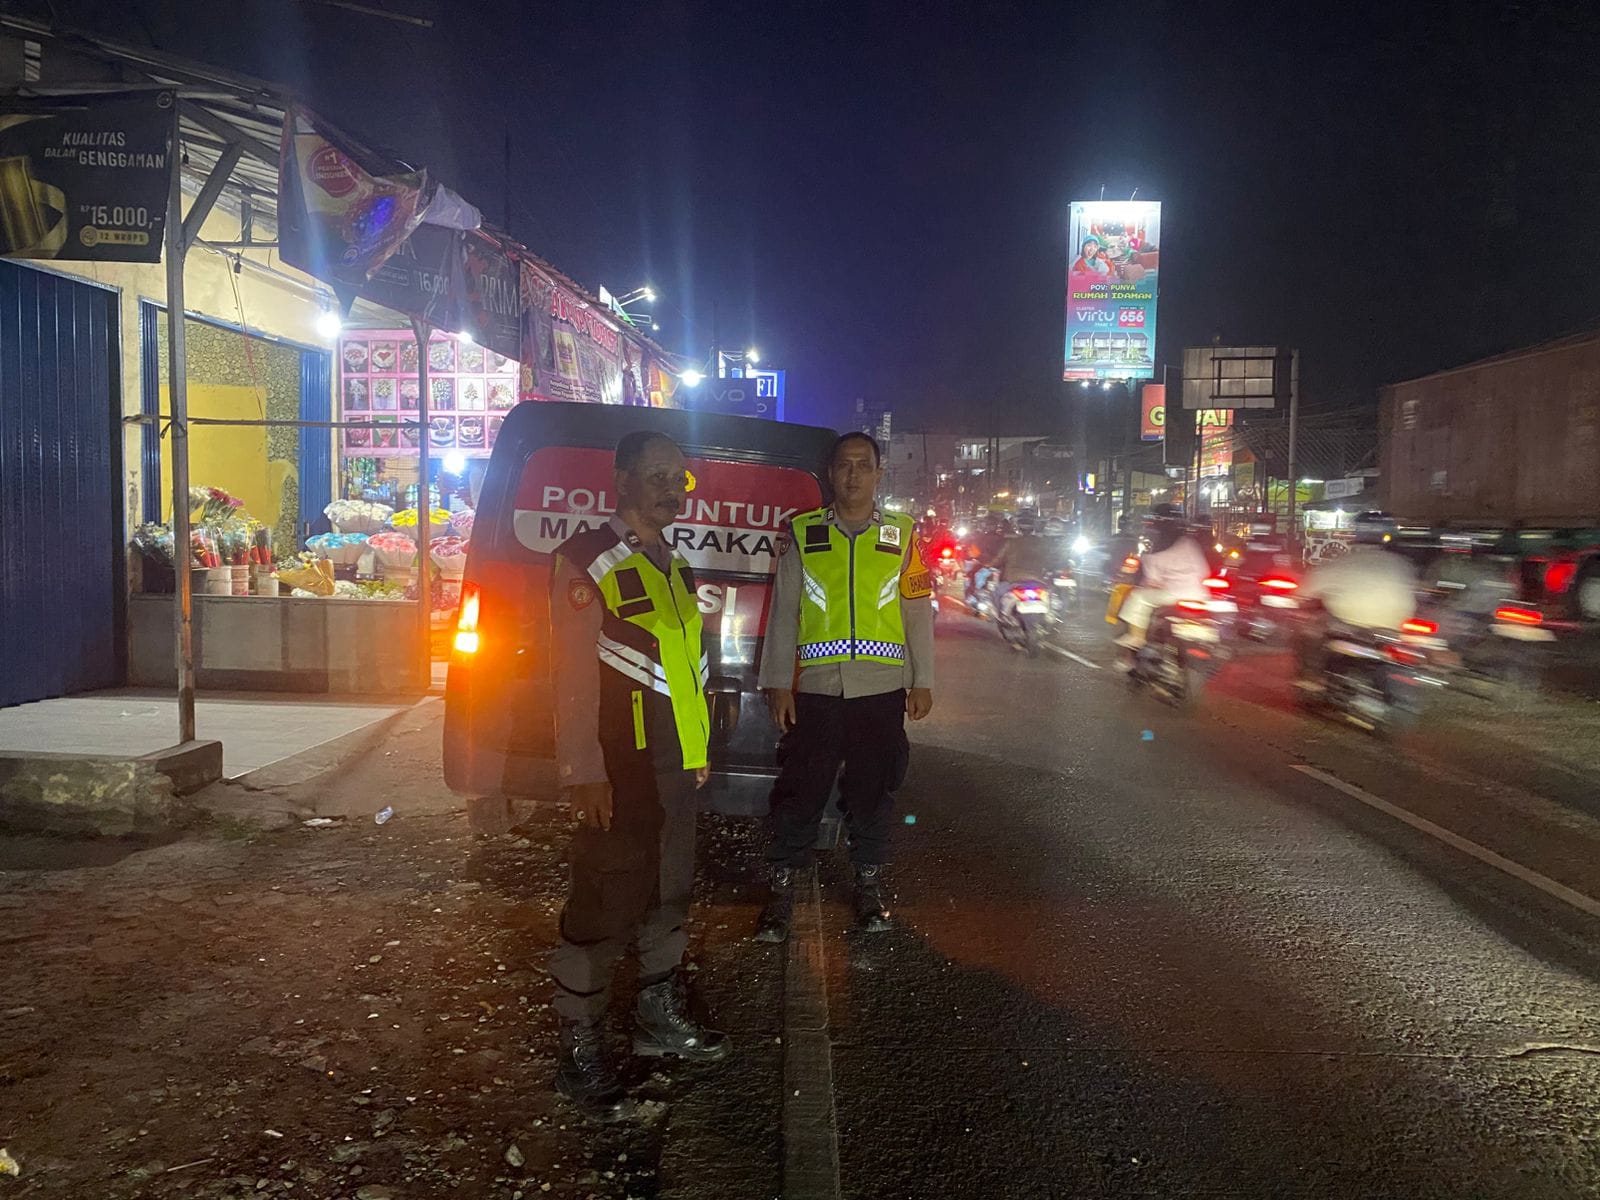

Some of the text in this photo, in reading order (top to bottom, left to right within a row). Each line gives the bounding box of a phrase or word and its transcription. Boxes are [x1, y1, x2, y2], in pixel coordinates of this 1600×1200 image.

[62, 132, 126, 147] KUALITAS
[44, 147, 164, 169] DALAM GENGGAMAN
[1119, 311, 1144, 322] 656
[541, 485, 616, 513] POL
